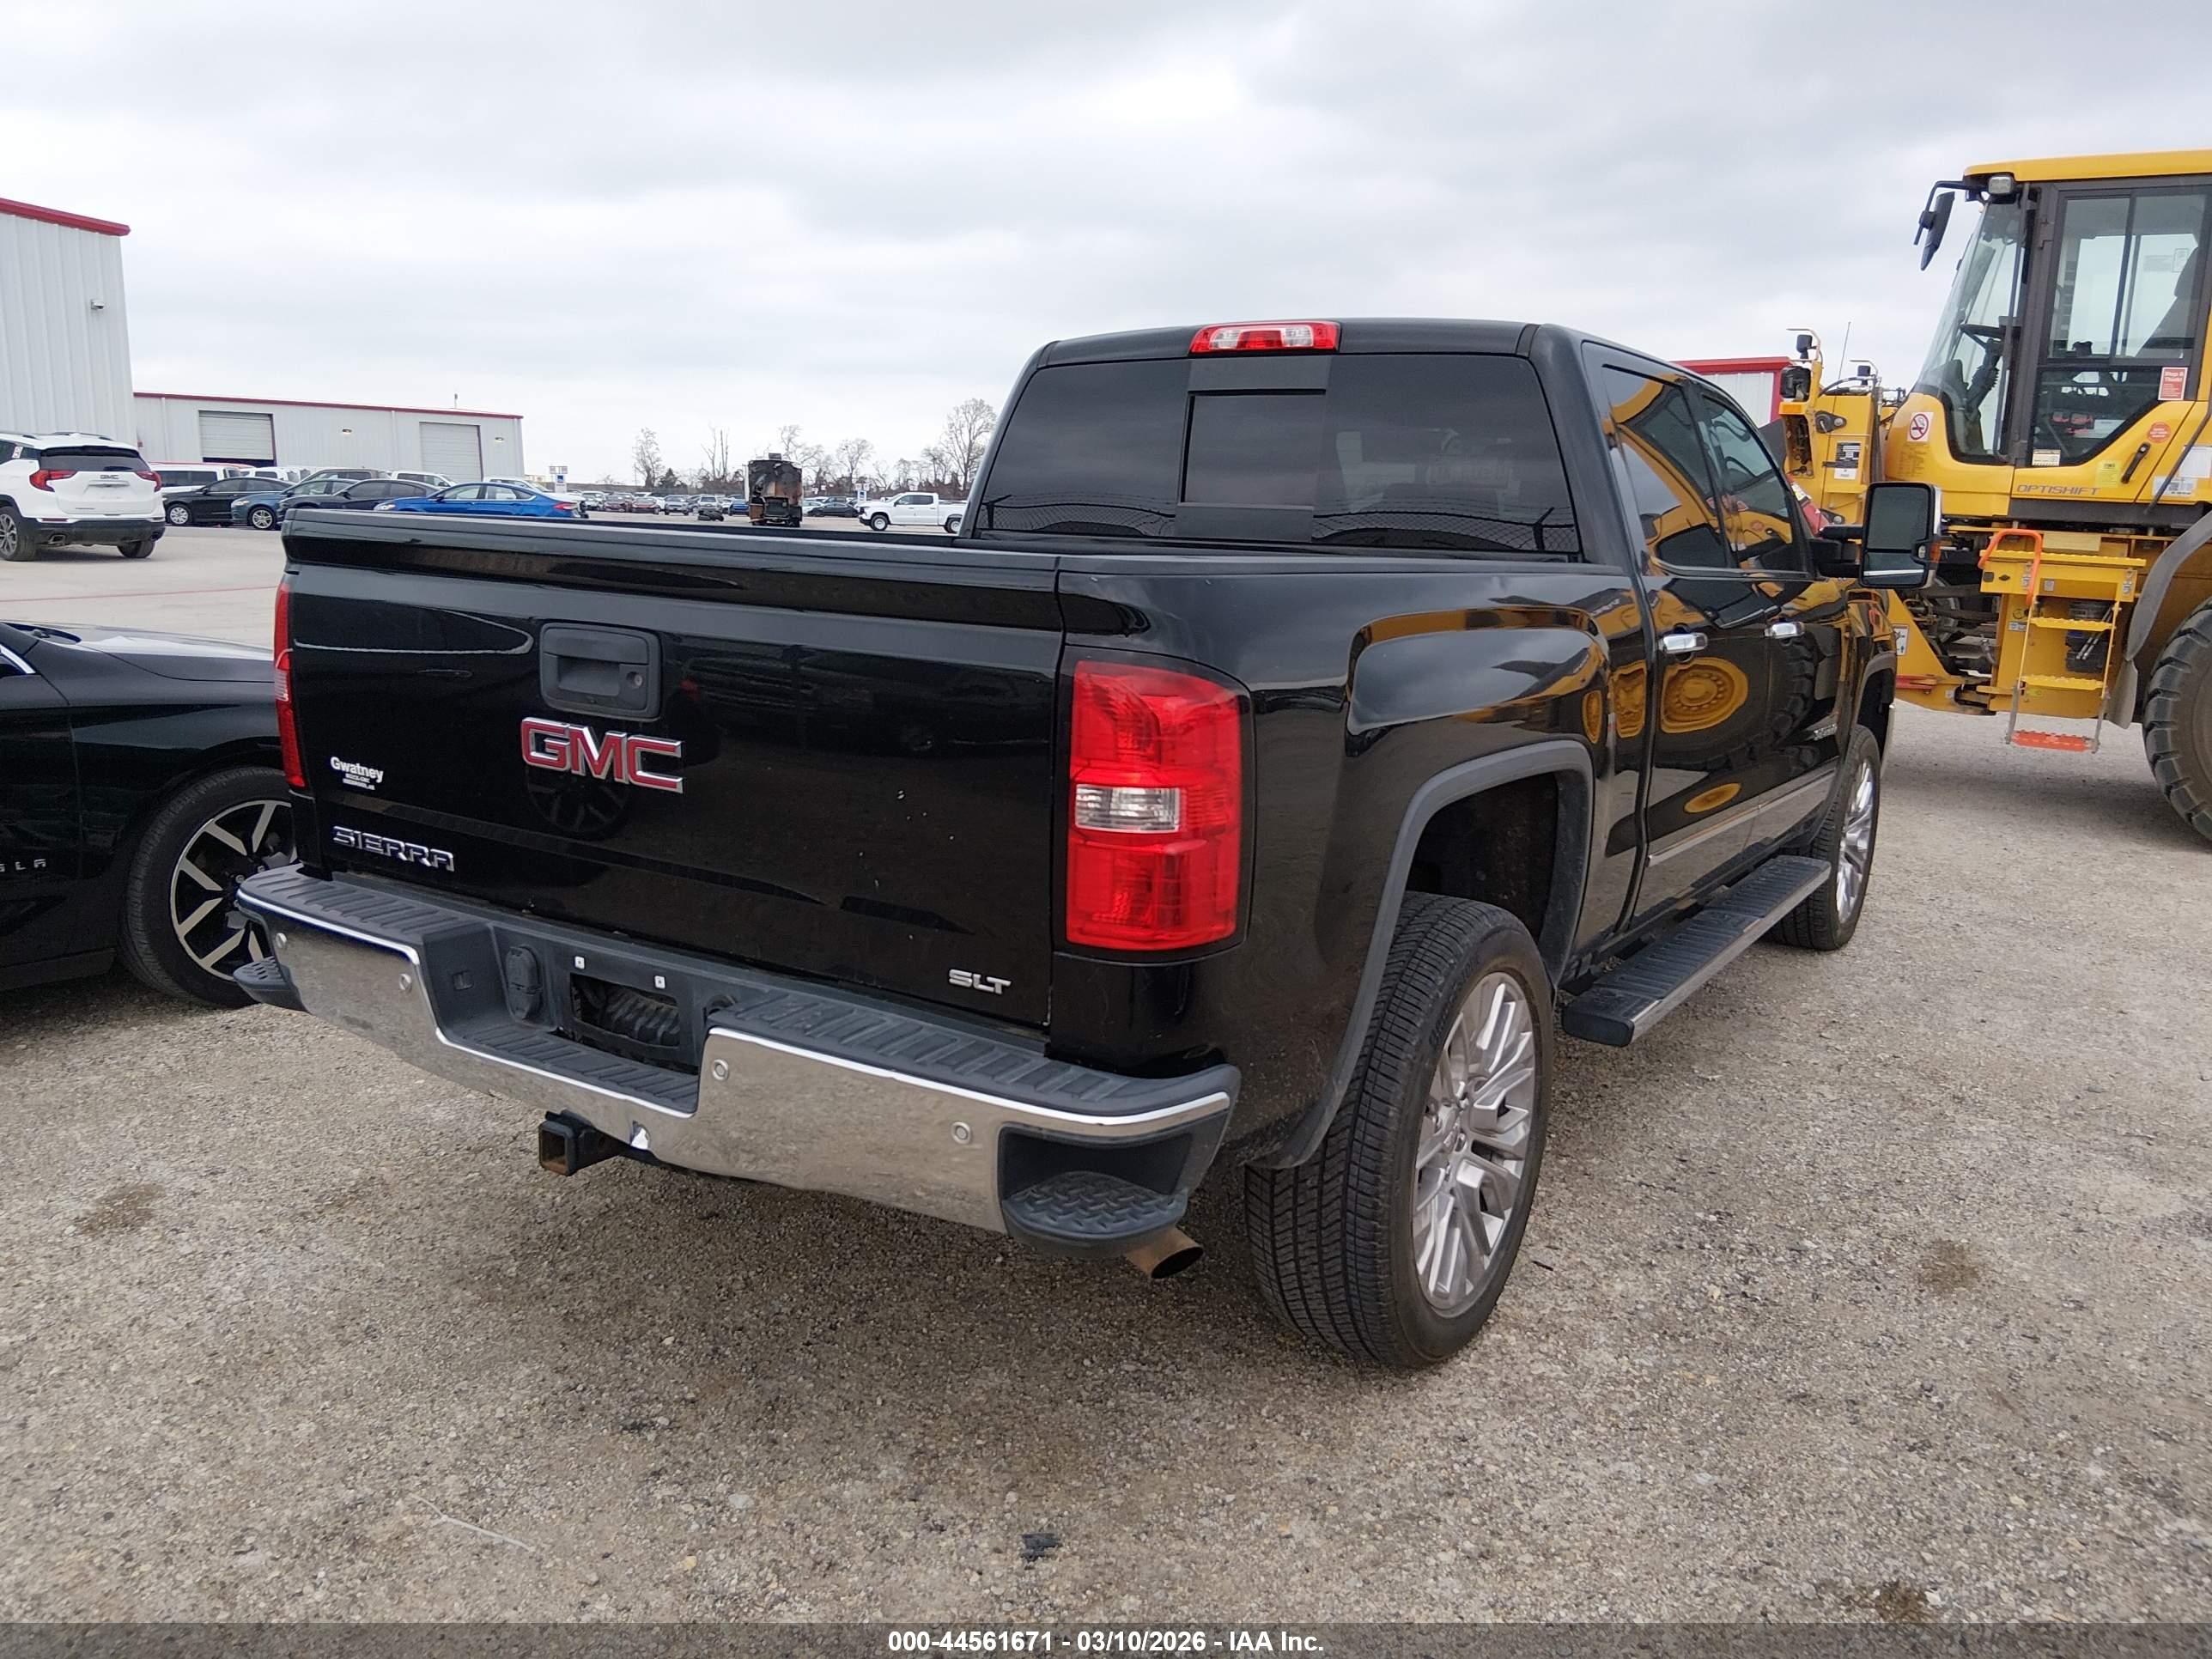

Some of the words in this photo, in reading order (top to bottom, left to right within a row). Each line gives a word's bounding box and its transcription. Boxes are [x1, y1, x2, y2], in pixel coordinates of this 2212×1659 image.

[2017, 484, 2100, 495] OPTISHIFT
[521, 716, 684, 794] GMC
[330, 756, 384, 783] Gwatney
[332, 825, 455, 873] SIERRA
[949, 969, 1012, 994] SLT
